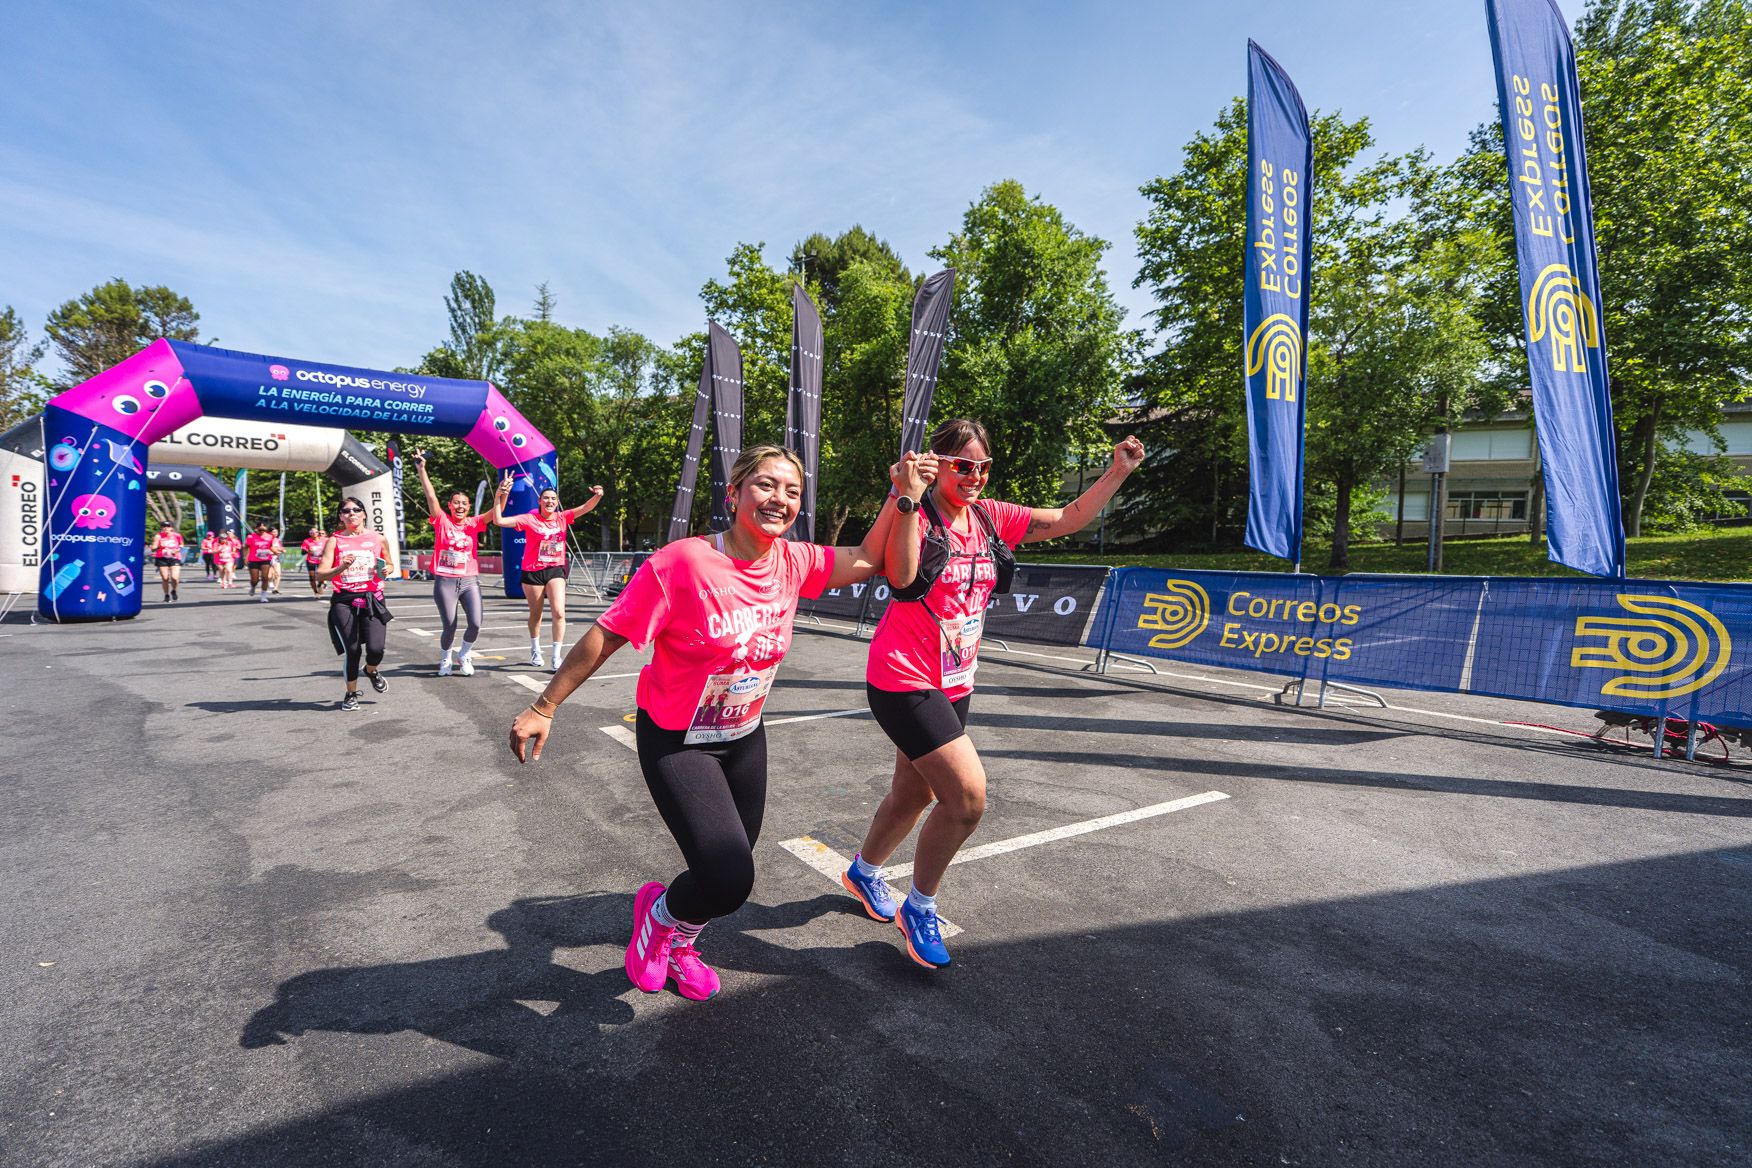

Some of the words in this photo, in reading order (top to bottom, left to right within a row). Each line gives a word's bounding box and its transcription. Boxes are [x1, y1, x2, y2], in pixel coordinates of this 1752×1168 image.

[258, 385, 278, 397] LA
[281, 388, 342, 404] ENERGÍA
[346, 396, 381, 408] PARA
[384, 400, 434, 413] CORRER
[255, 399, 266, 407] A
[270, 400, 288, 410] LA
[293, 402, 370, 419] VELOCIDAD
[373, 411, 390, 420] DE
[392, 412, 407, 422] LA
[410, 414, 435, 424] LUZ
[159, 433, 182, 445] L
[187, 432, 279, 451] CORREO
[371, 492, 382, 506] EL
[21, 481, 38, 545] CORREO
[373, 508, 384, 535] COR
[22, 549, 38, 567] EL
[699, 585, 736, 600] OYSHO
[1228, 591, 1361, 625] Correos
[1219, 623, 1353, 660] Express
[722, 703, 750, 718] 016
[695, 732, 722, 740] OYSHO
